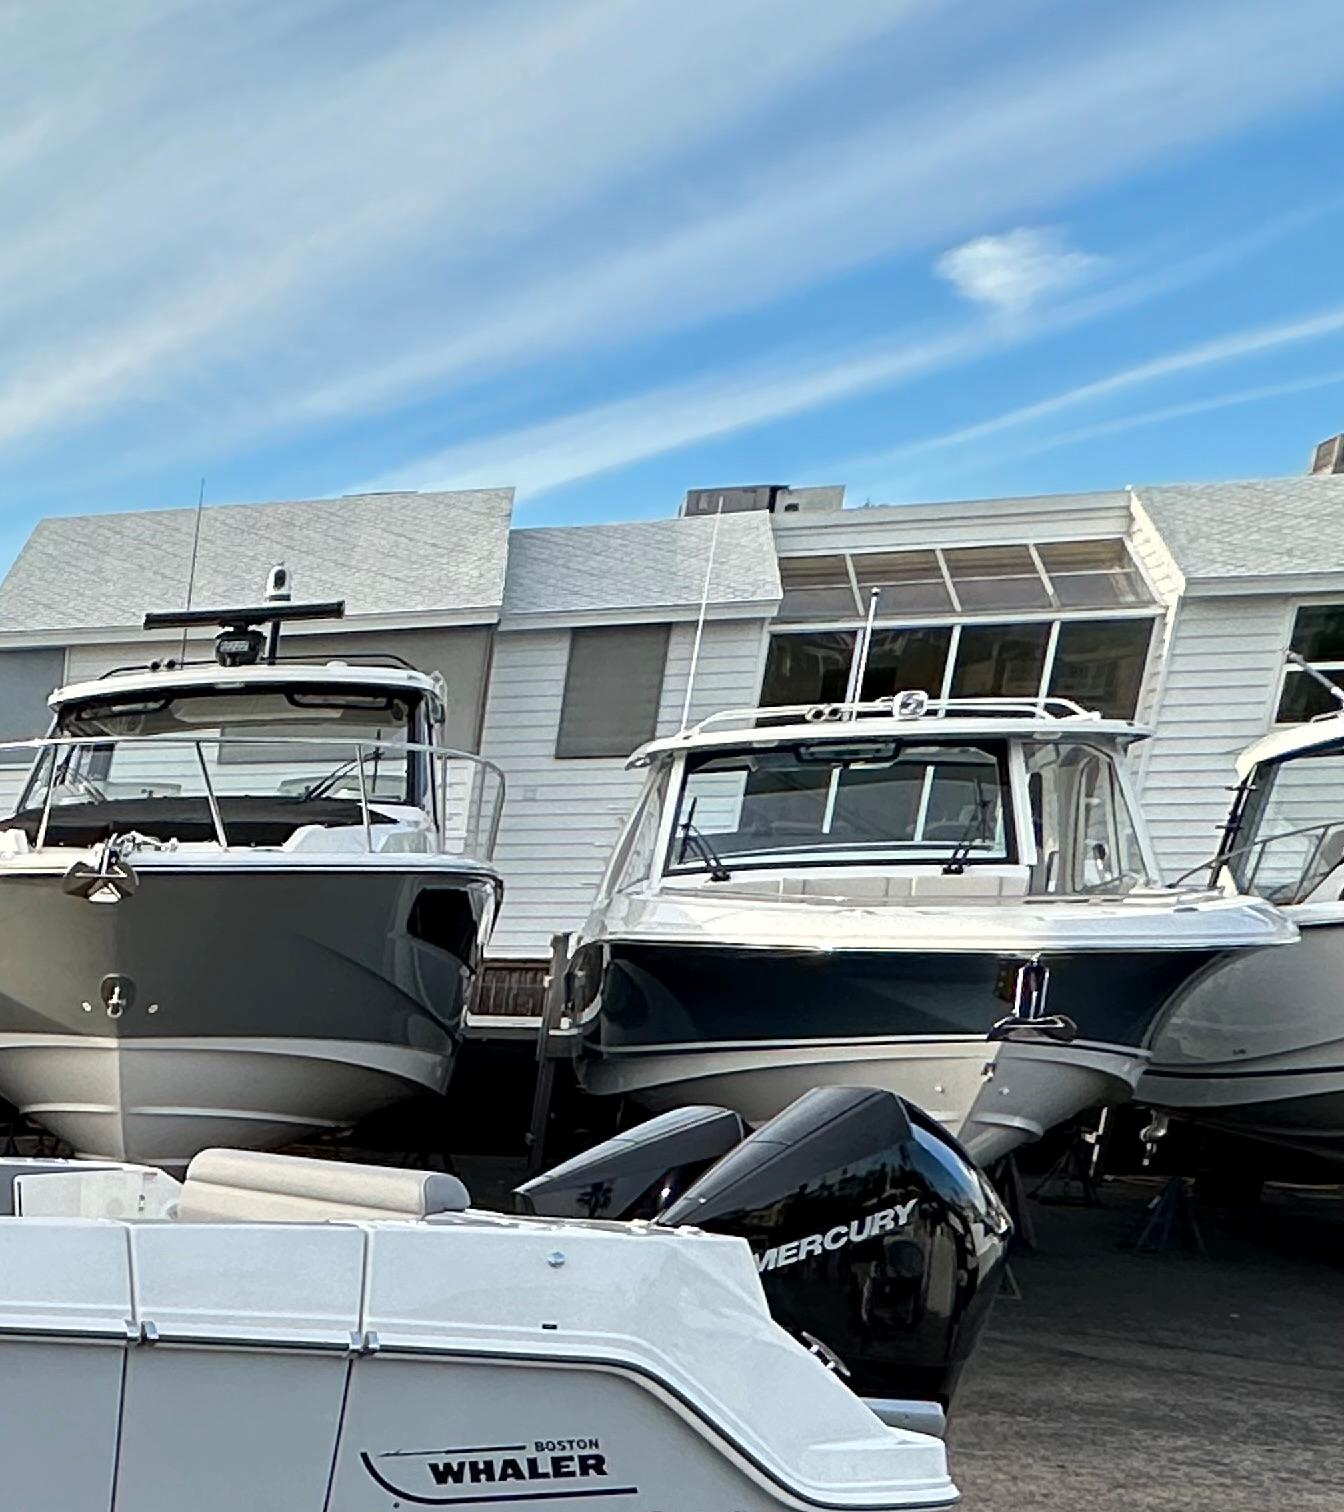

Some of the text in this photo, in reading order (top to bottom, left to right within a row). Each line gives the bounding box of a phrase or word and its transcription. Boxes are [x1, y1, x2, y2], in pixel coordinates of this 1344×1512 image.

[753, 1198, 919, 1272] MERCURY
[534, 1438, 600, 1452] BOSTON
[428, 1453, 608, 1486] WHALER
